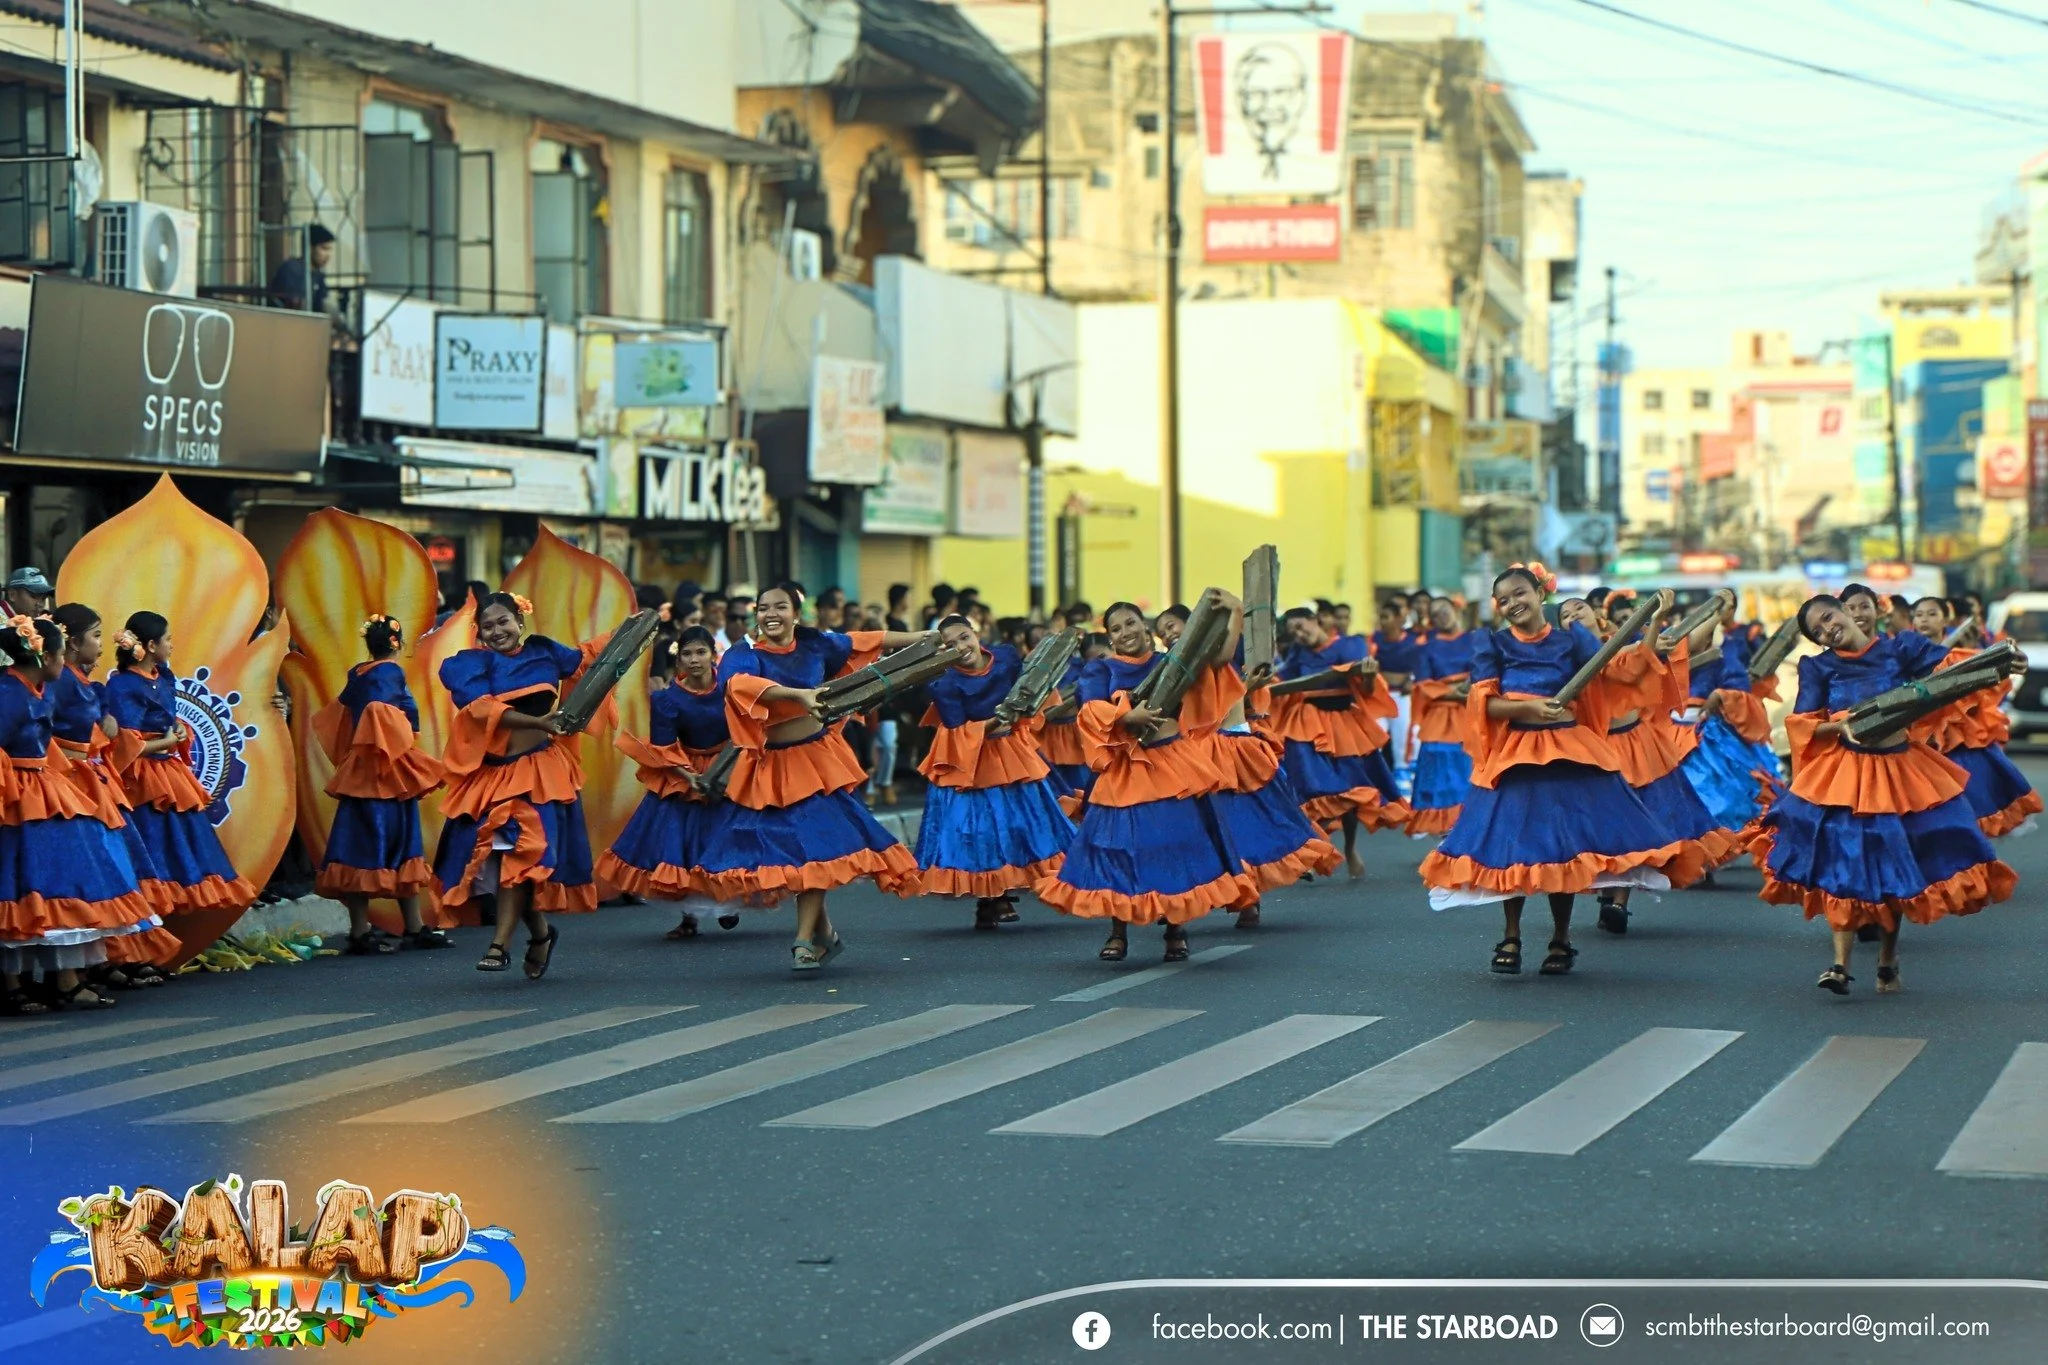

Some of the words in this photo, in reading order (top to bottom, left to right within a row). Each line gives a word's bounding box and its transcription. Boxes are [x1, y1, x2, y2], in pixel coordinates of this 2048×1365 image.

[446, 336, 538, 373] PRAXY
[143, 395, 223, 436] SPECS
[176, 441, 219, 461] VISION
[177, 702, 203, 724] SINESS
[197, 720, 215, 739] AND
[201, 738, 221, 791] TECHNOLOG
